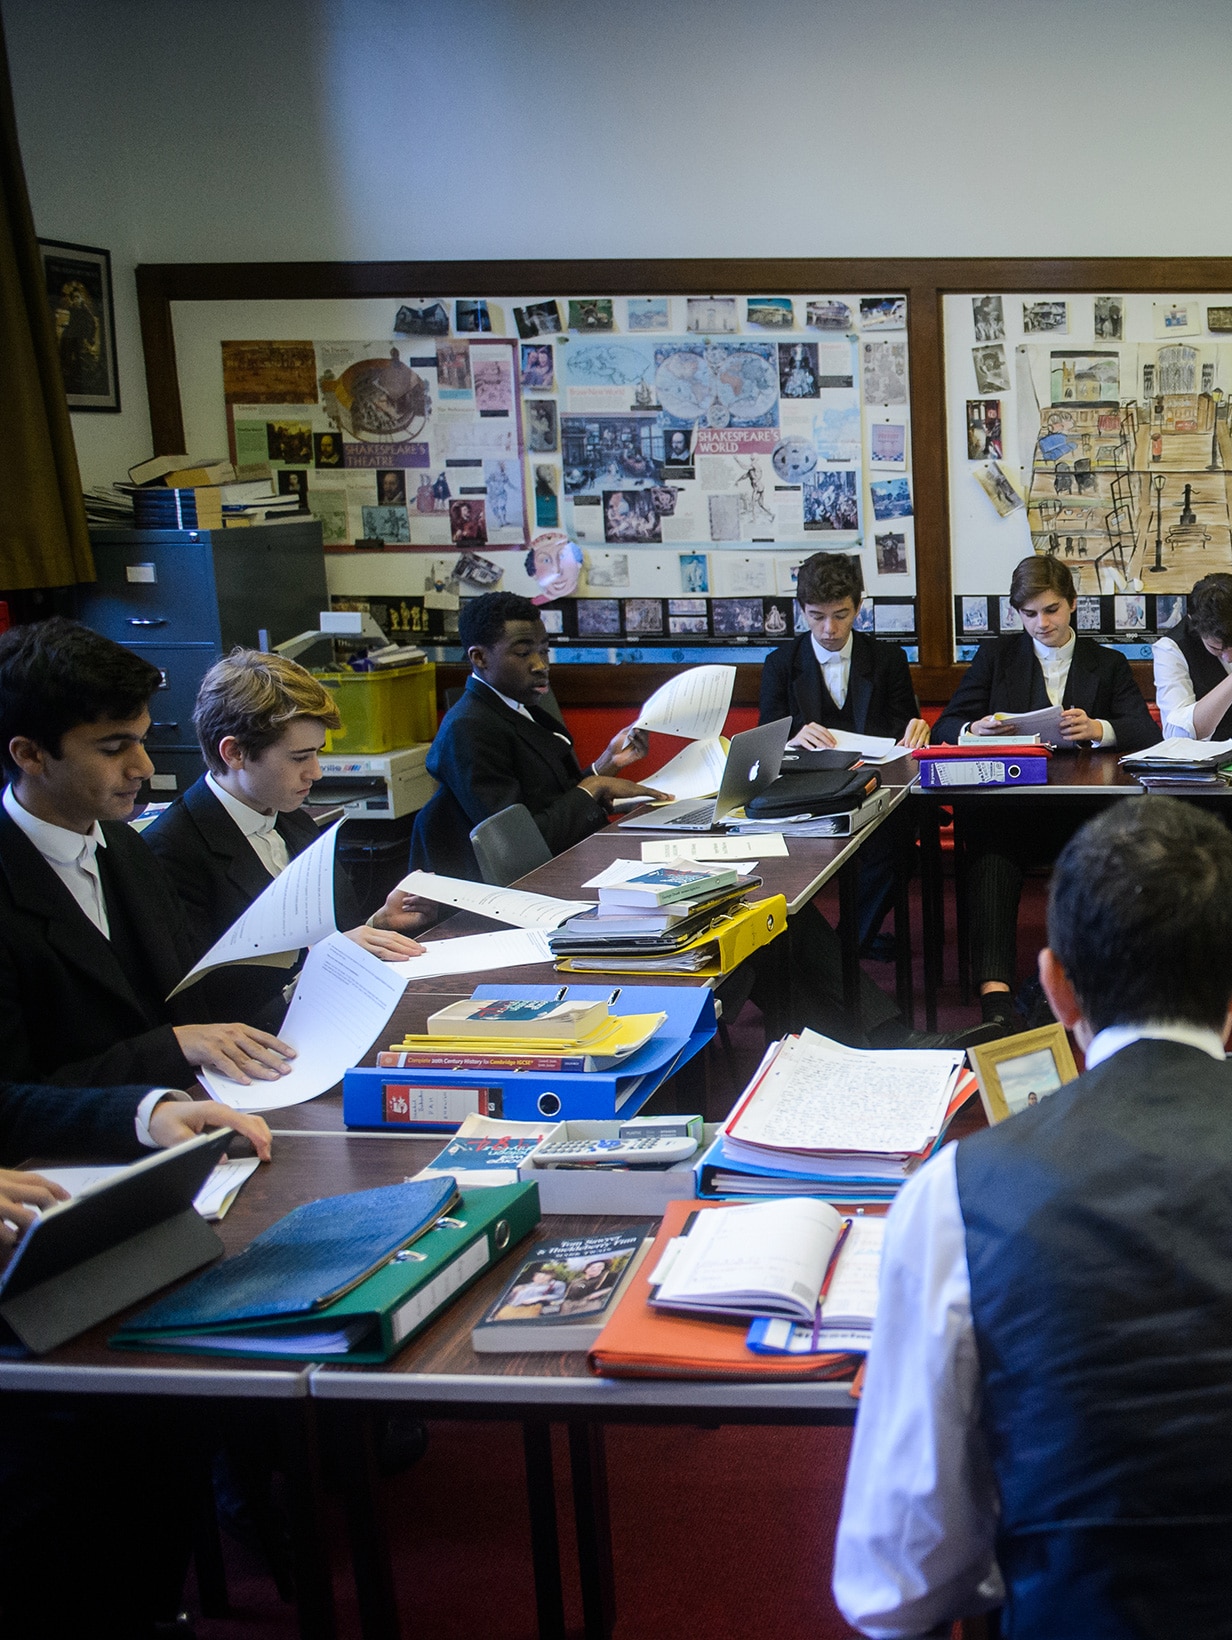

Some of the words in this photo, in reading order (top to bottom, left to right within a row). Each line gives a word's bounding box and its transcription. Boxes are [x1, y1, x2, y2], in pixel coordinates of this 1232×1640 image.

[698, 430, 779, 442] SHAKESPEARE'S
[346, 444, 426, 455] SHAKESPEARE'S
[700, 442, 739, 453] WORLD
[347, 456, 394, 466] THEATRE
[548, 1242, 611, 1254] Huckleberry
[613, 1237, 637, 1246] Finn
[585, 1235, 622, 1245] Sawyer
